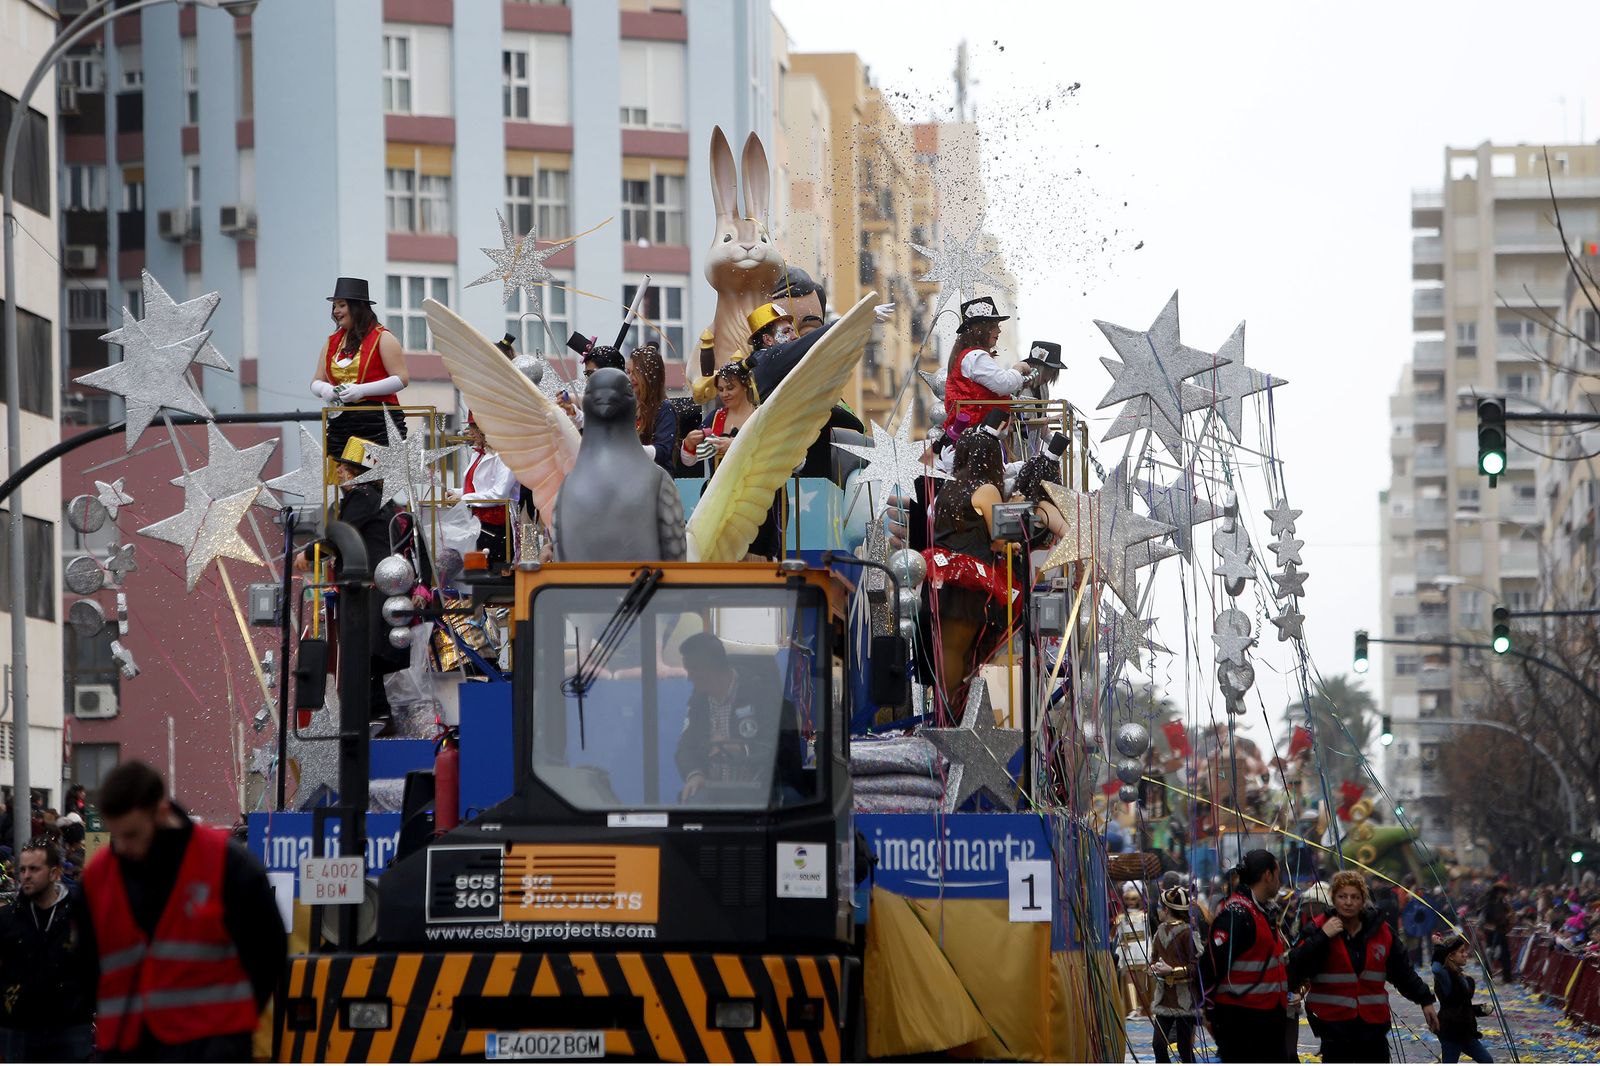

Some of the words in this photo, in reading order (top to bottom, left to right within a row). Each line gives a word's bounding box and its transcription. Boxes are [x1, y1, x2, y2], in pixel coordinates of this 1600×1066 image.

[306, 865, 314, 879] E
[322, 864, 358, 878] 4002
[455, 875, 495, 889] ecs
[316, 883, 347, 898] BGM
[1021, 873, 1042, 911] 1
[455, 892, 495, 908] 360
[520, 891, 642, 910] PROJECTS
[425, 923, 656, 942] www.ecsbigprojects.com
